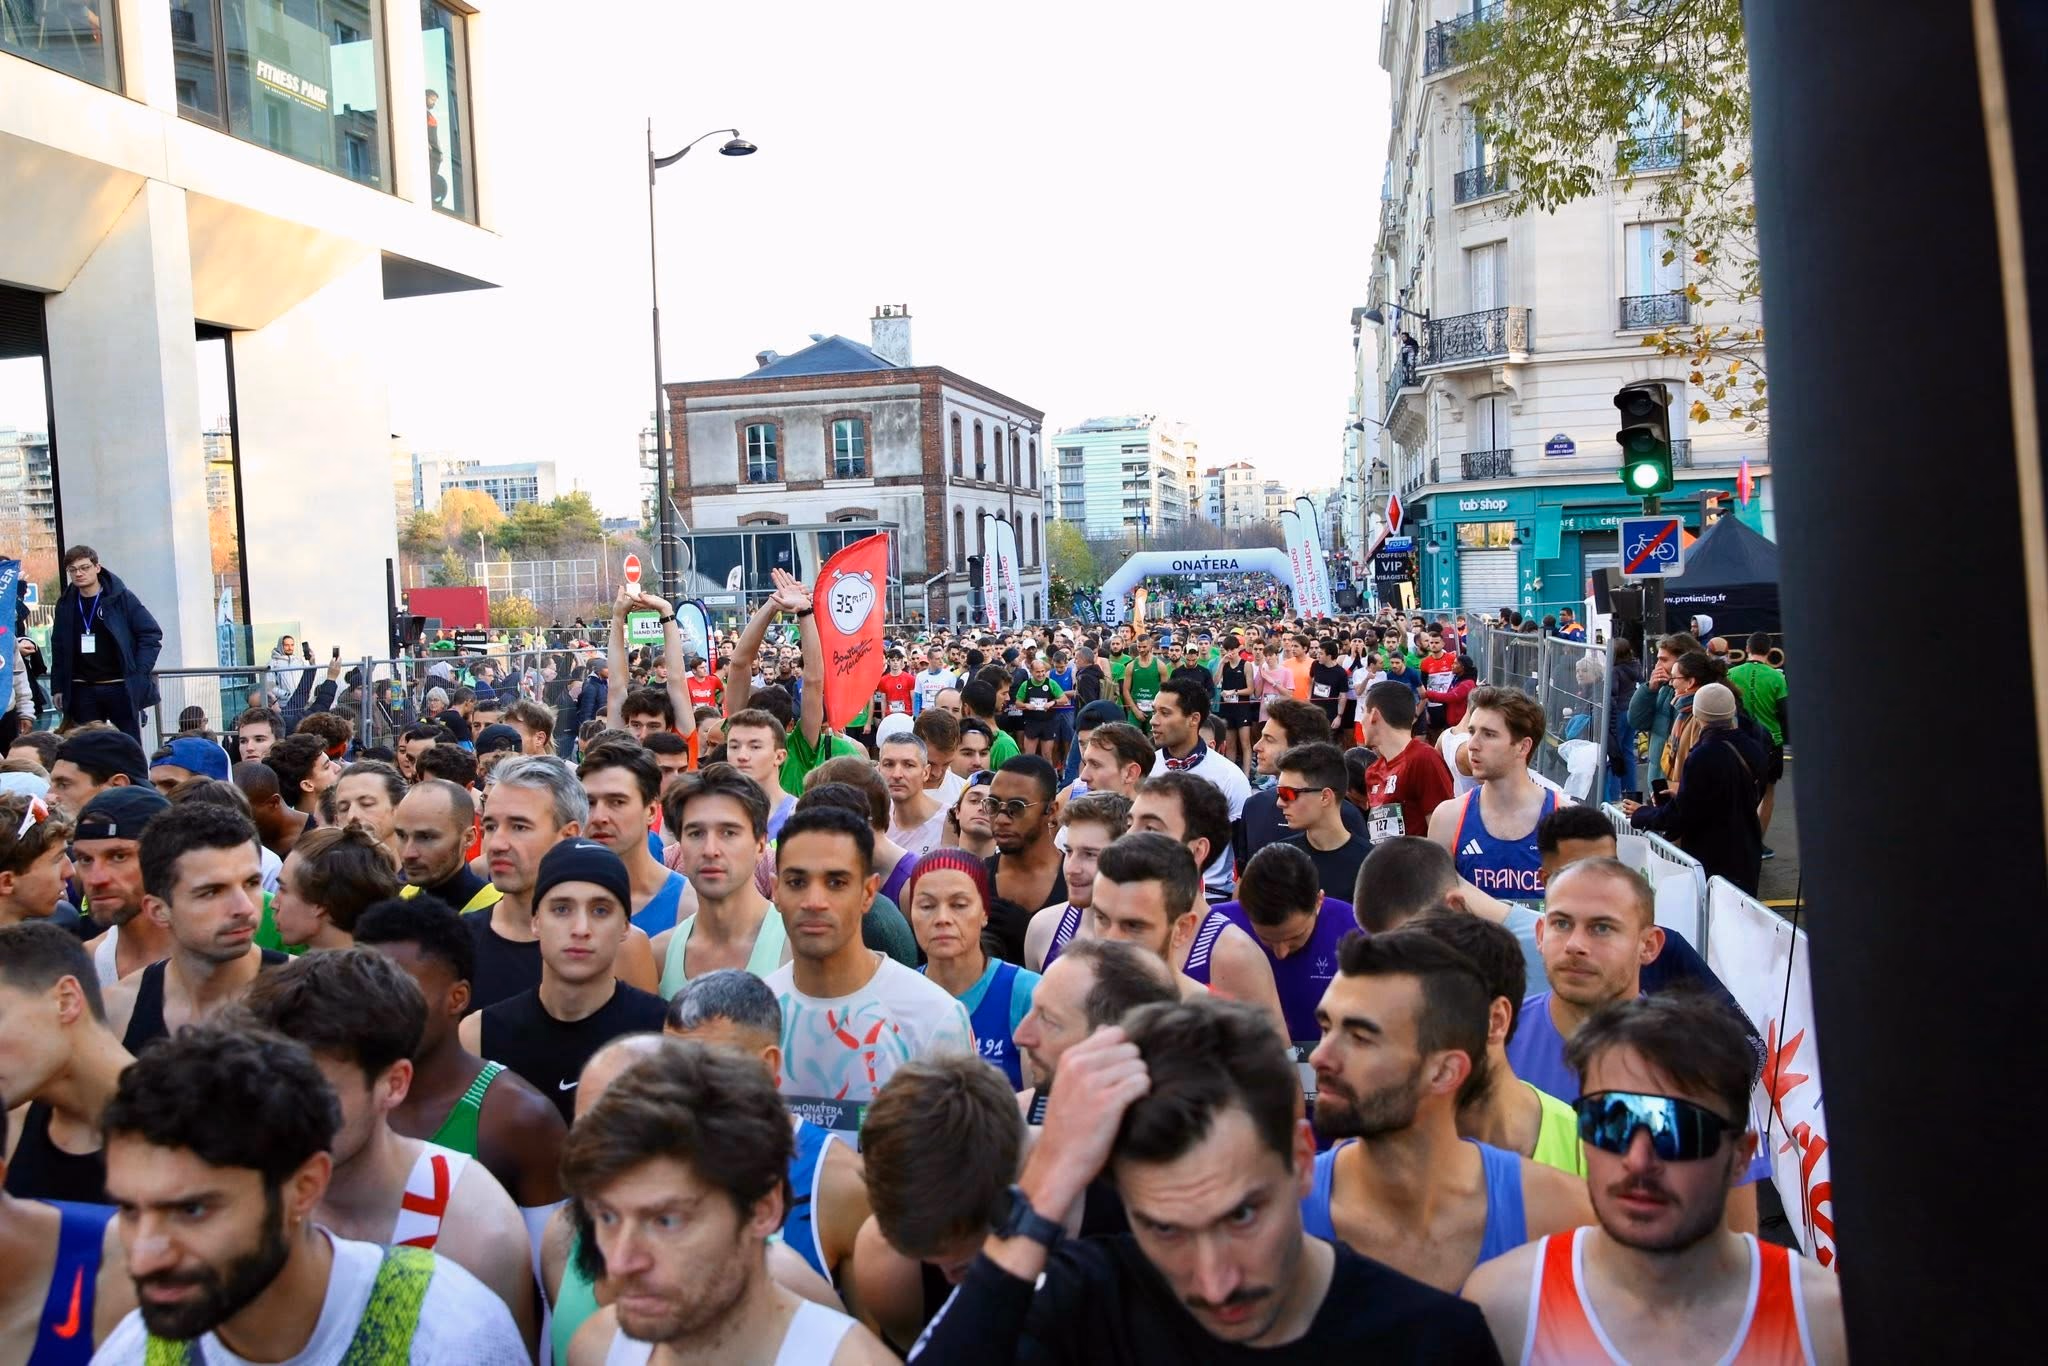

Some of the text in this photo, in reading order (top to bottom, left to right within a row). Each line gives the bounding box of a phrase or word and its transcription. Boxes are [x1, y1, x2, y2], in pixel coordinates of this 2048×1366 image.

[256, 60, 300, 92] FITNESS
[301, 79, 328, 105] PARK
[1559, 519, 1574, 527] AFÉ
[1172, 556, 1239, 571] ONATERA
[1381, 561, 1403, 572] VIP
[836, 593, 853, 613] 35
[1376, 819, 1388, 831] 127
[1474, 868, 1545, 890] FRANCE
[802, 1101, 843, 1116] ONATERA
